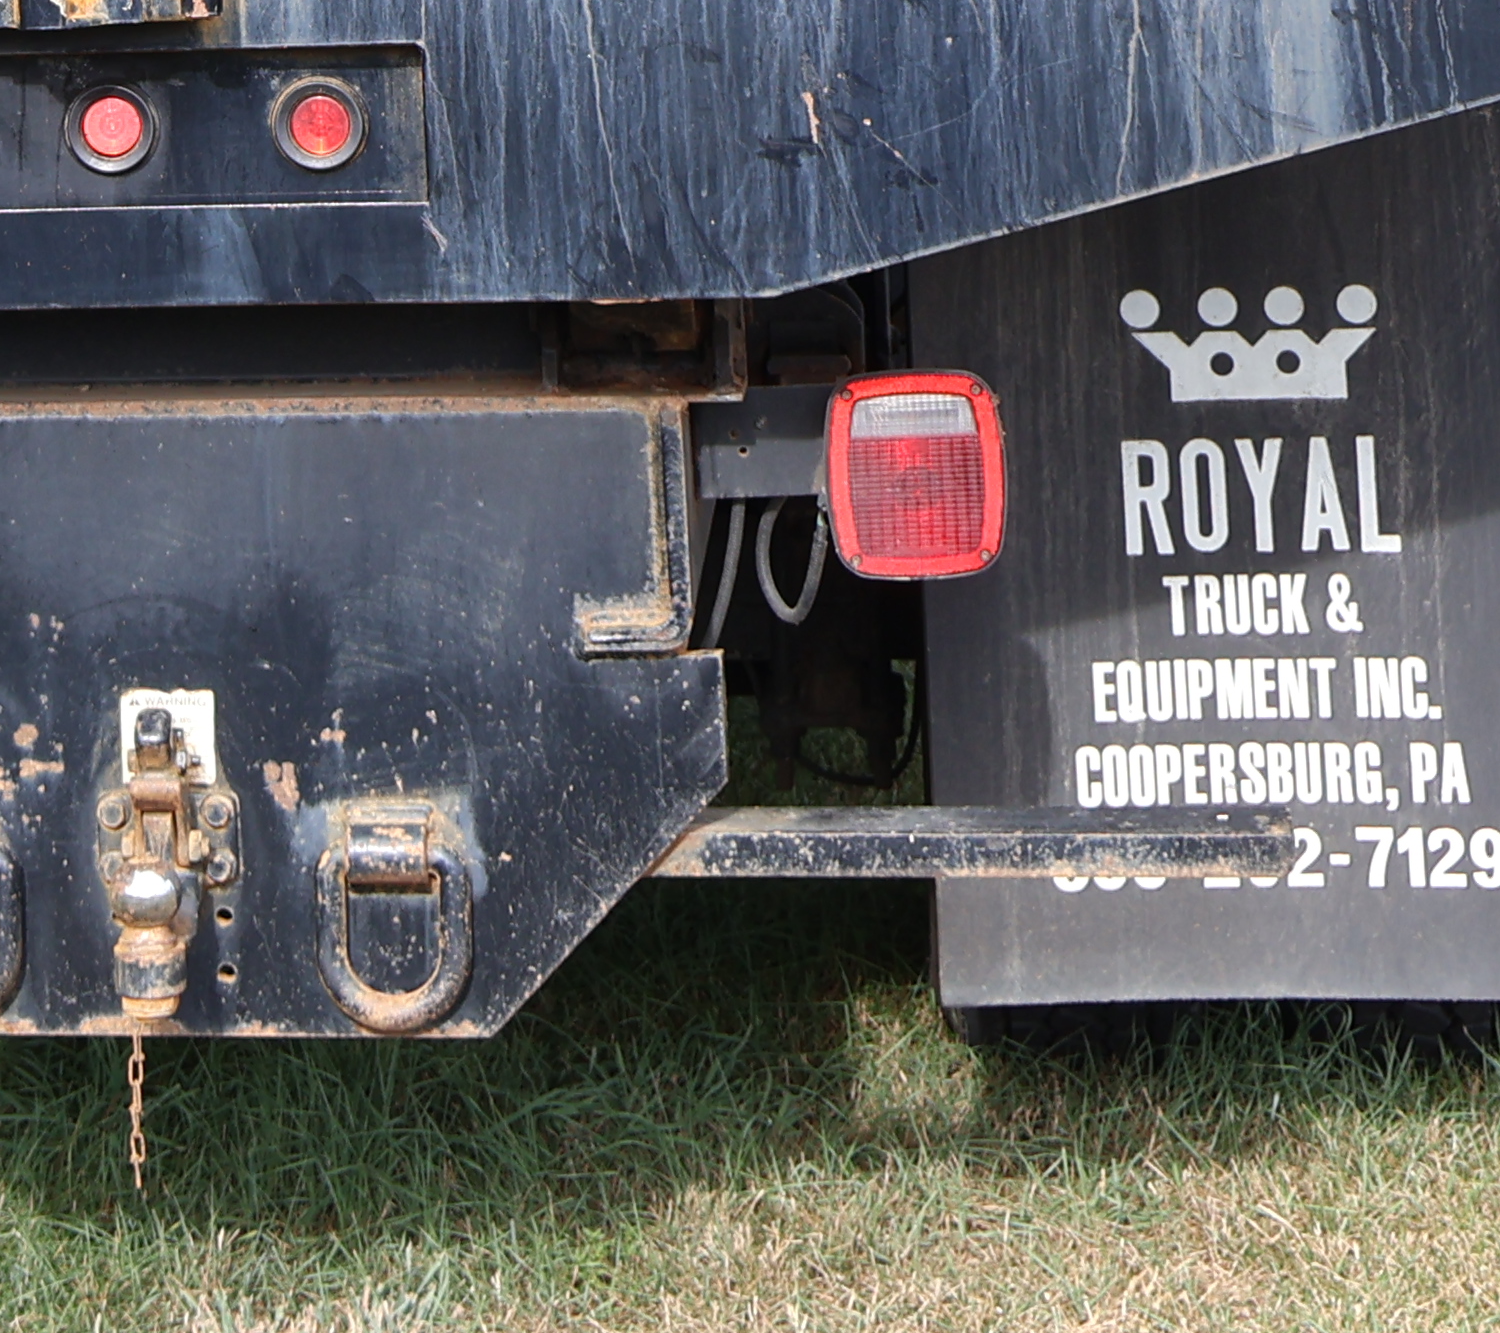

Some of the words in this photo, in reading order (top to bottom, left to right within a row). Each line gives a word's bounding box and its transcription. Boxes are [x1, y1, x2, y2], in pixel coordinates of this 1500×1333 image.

[1120, 434, 1402, 556] ROYAL
[1163, 573, 1309, 637] TRUCK
[1324, 572, 1364, 633] &
[145, 696, 206, 707] WARNING
[1092, 657, 1337, 723] EQUIPMENT
[1355, 656, 1443, 720] INC.
[1074, 741, 1399, 811] COOPERSBURG,
[1409, 741, 1471, 806] PA
